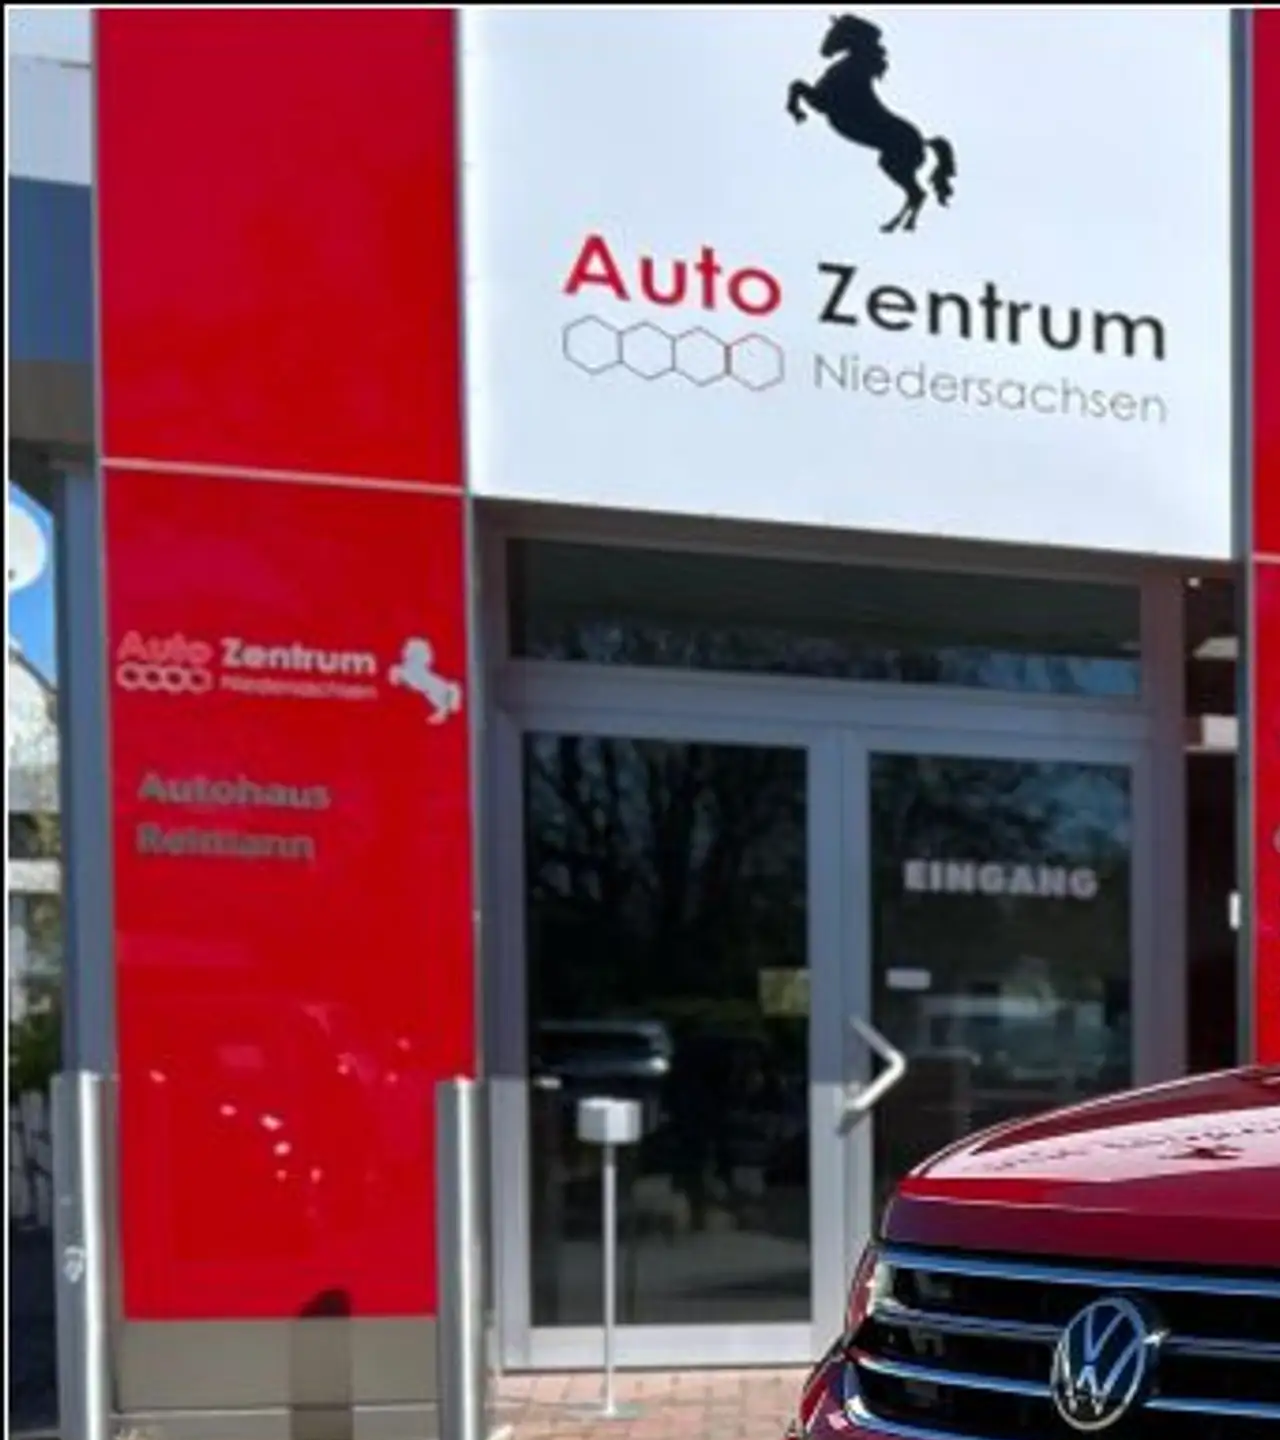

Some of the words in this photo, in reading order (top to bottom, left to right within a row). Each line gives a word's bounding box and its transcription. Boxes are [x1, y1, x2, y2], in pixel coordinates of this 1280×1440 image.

[563, 234, 783, 317] Auto
[815, 261, 1167, 362] Zentrum
[813, 353, 1168, 424] Niedersachsen
[116, 630, 214, 665] Auto
[221, 637, 378, 676] Zentrum
[138, 773, 331, 809] Autohaus
[904, 859, 1099, 899] EINGANG
